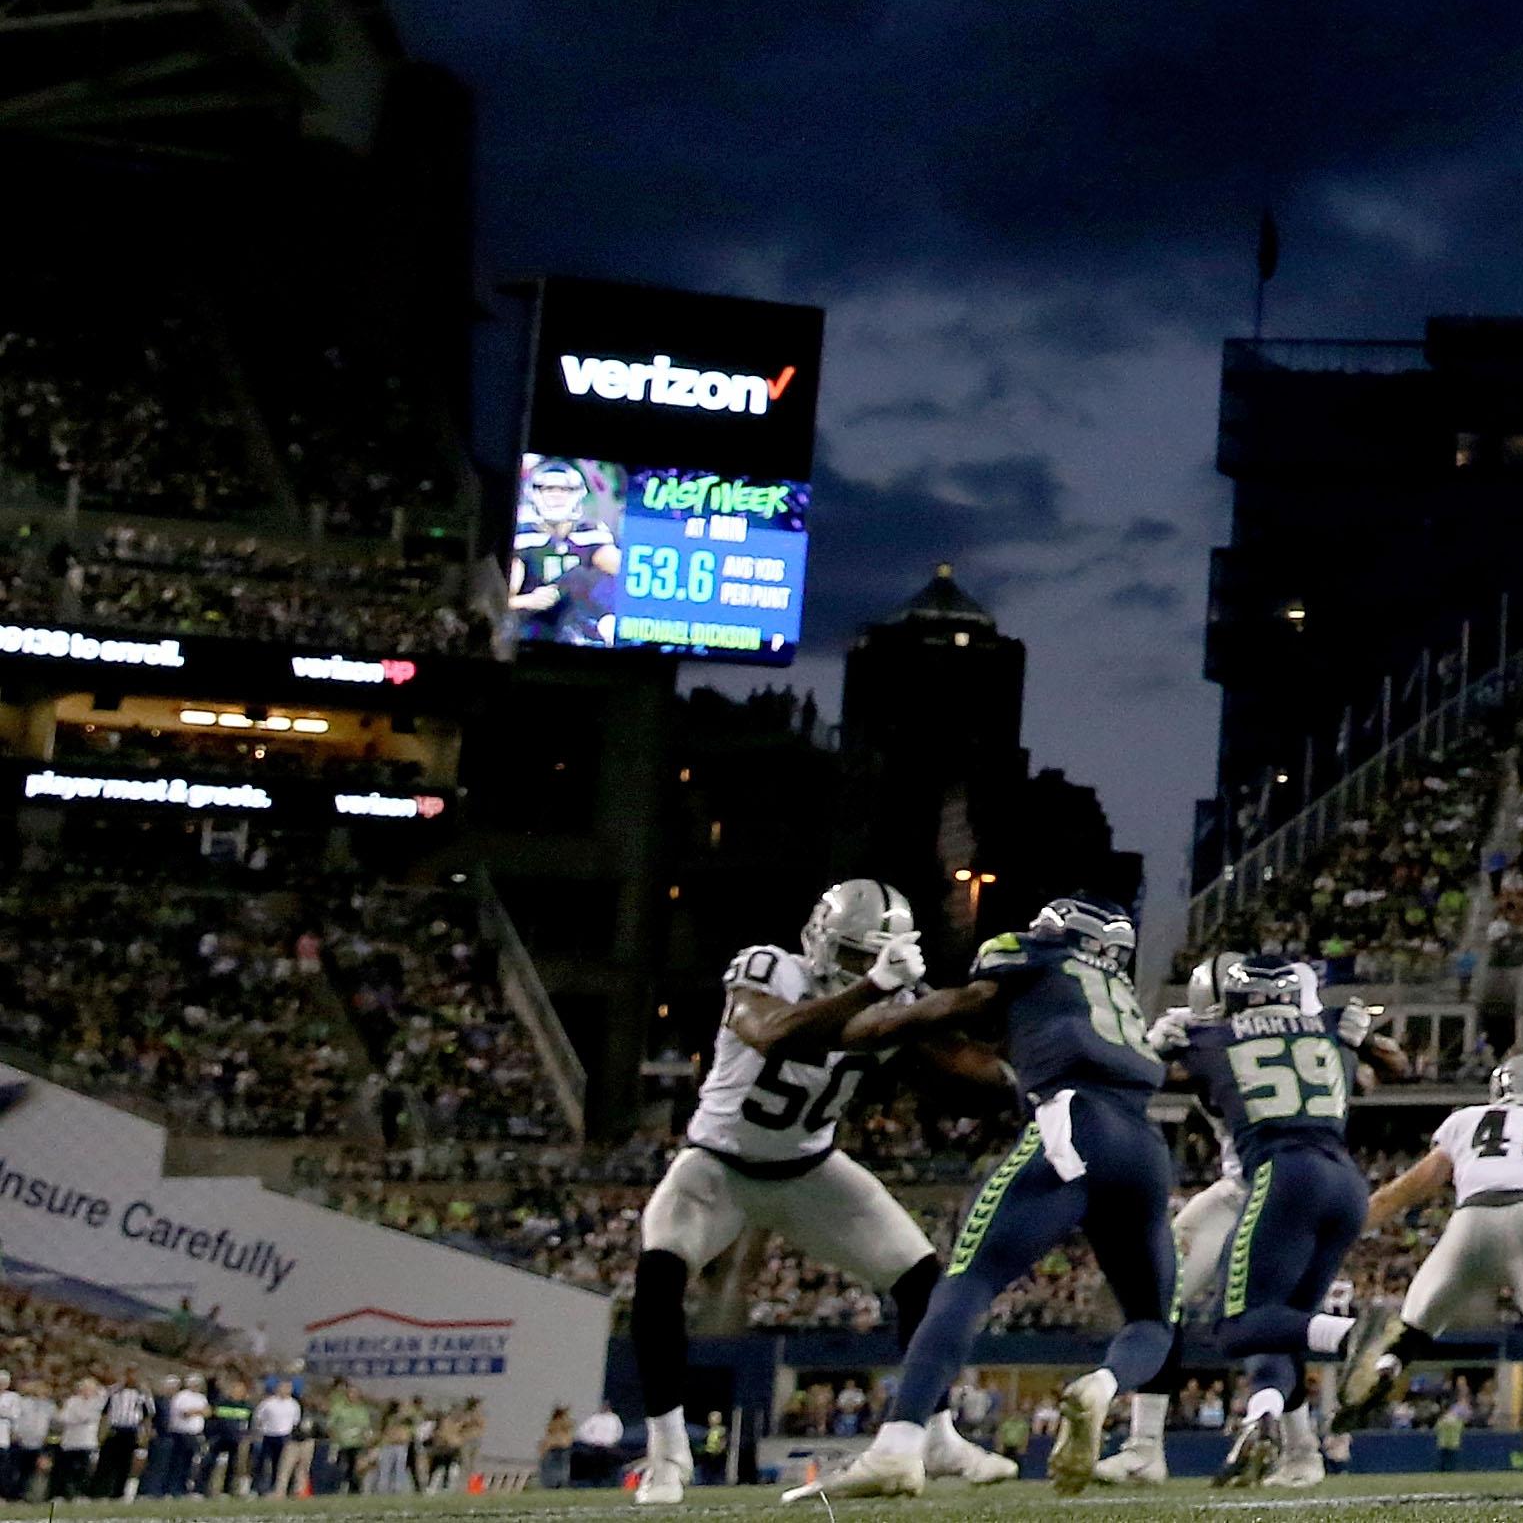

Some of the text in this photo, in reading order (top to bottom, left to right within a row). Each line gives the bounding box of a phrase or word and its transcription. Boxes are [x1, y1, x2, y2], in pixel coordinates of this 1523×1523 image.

[560, 355, 768, 415] verizon
[625, 544, 716, 603] 53.6
[1227, 1037, 1347, 1124] 59
[121, 1199, 296, 1293] Carefully
